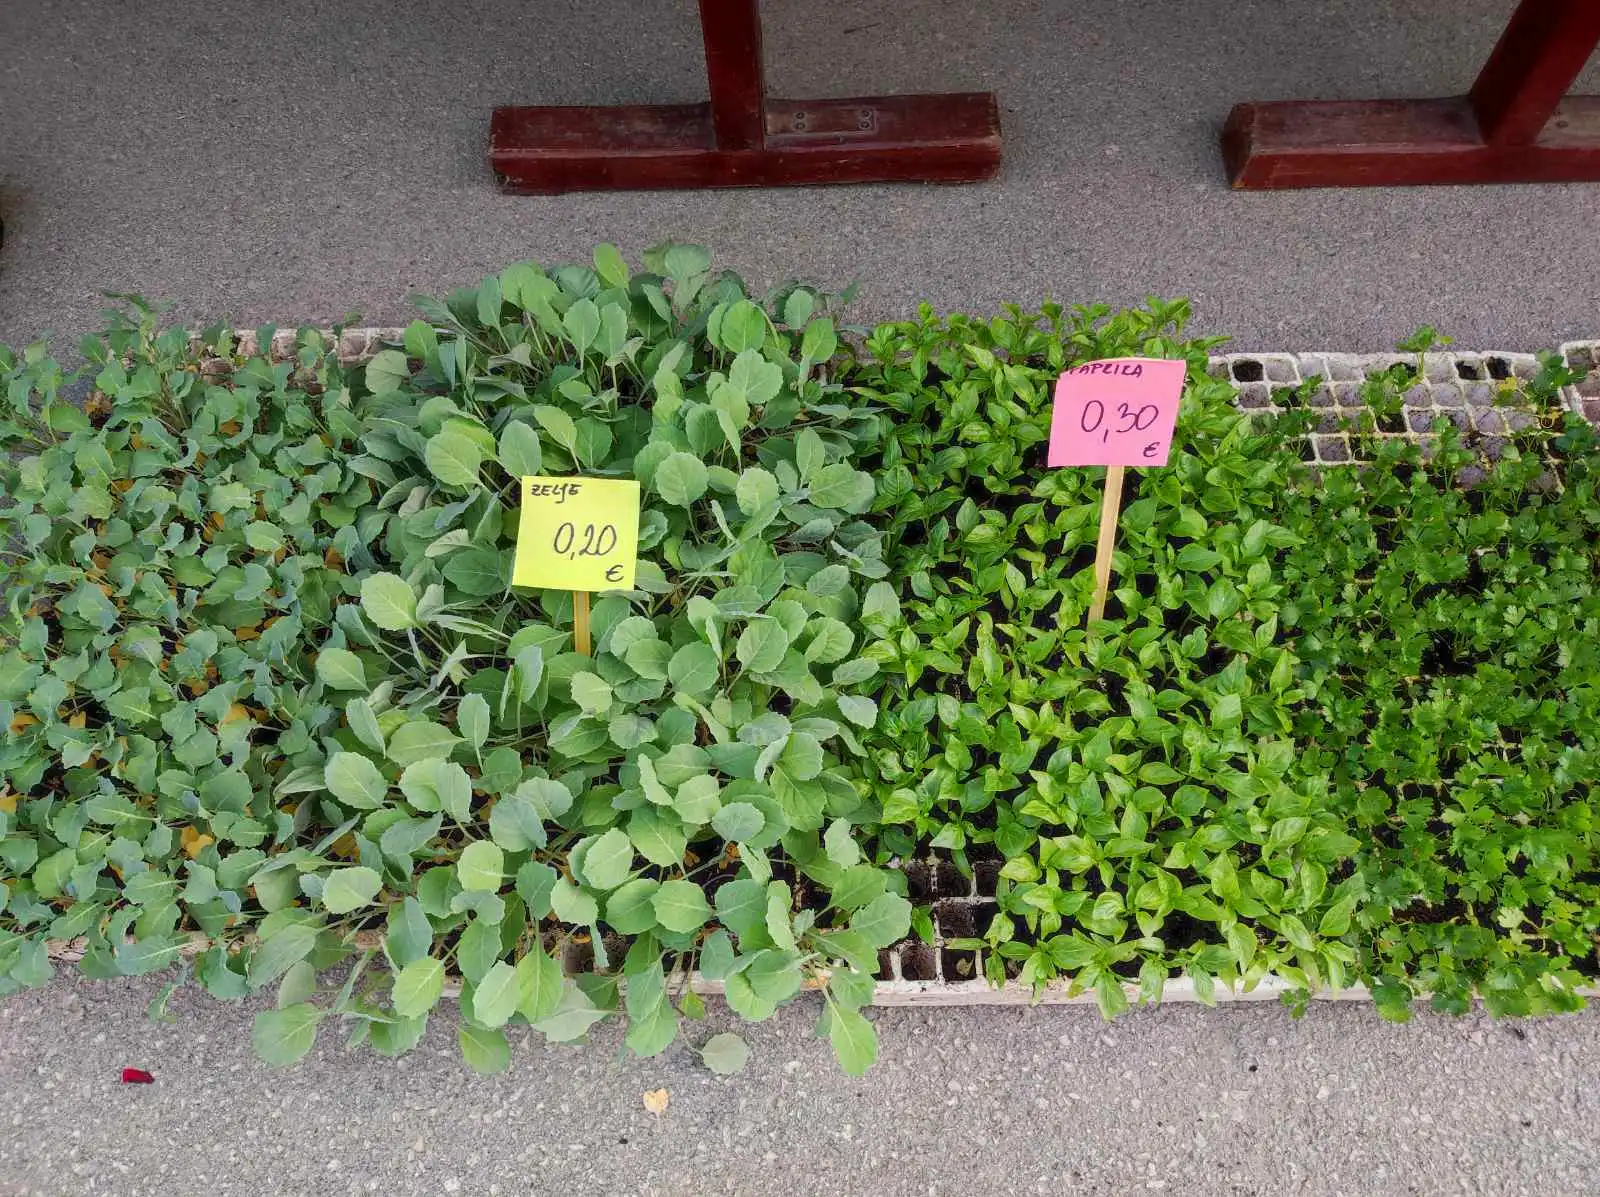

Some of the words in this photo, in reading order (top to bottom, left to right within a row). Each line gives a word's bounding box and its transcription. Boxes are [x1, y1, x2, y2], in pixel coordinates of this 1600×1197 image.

[1081, 400, 1159, 443] 0,30
[1143, 441, 1161, 458] €
[553, 522, 617, 561] 0,20
[605, 564, 625, 583] €
